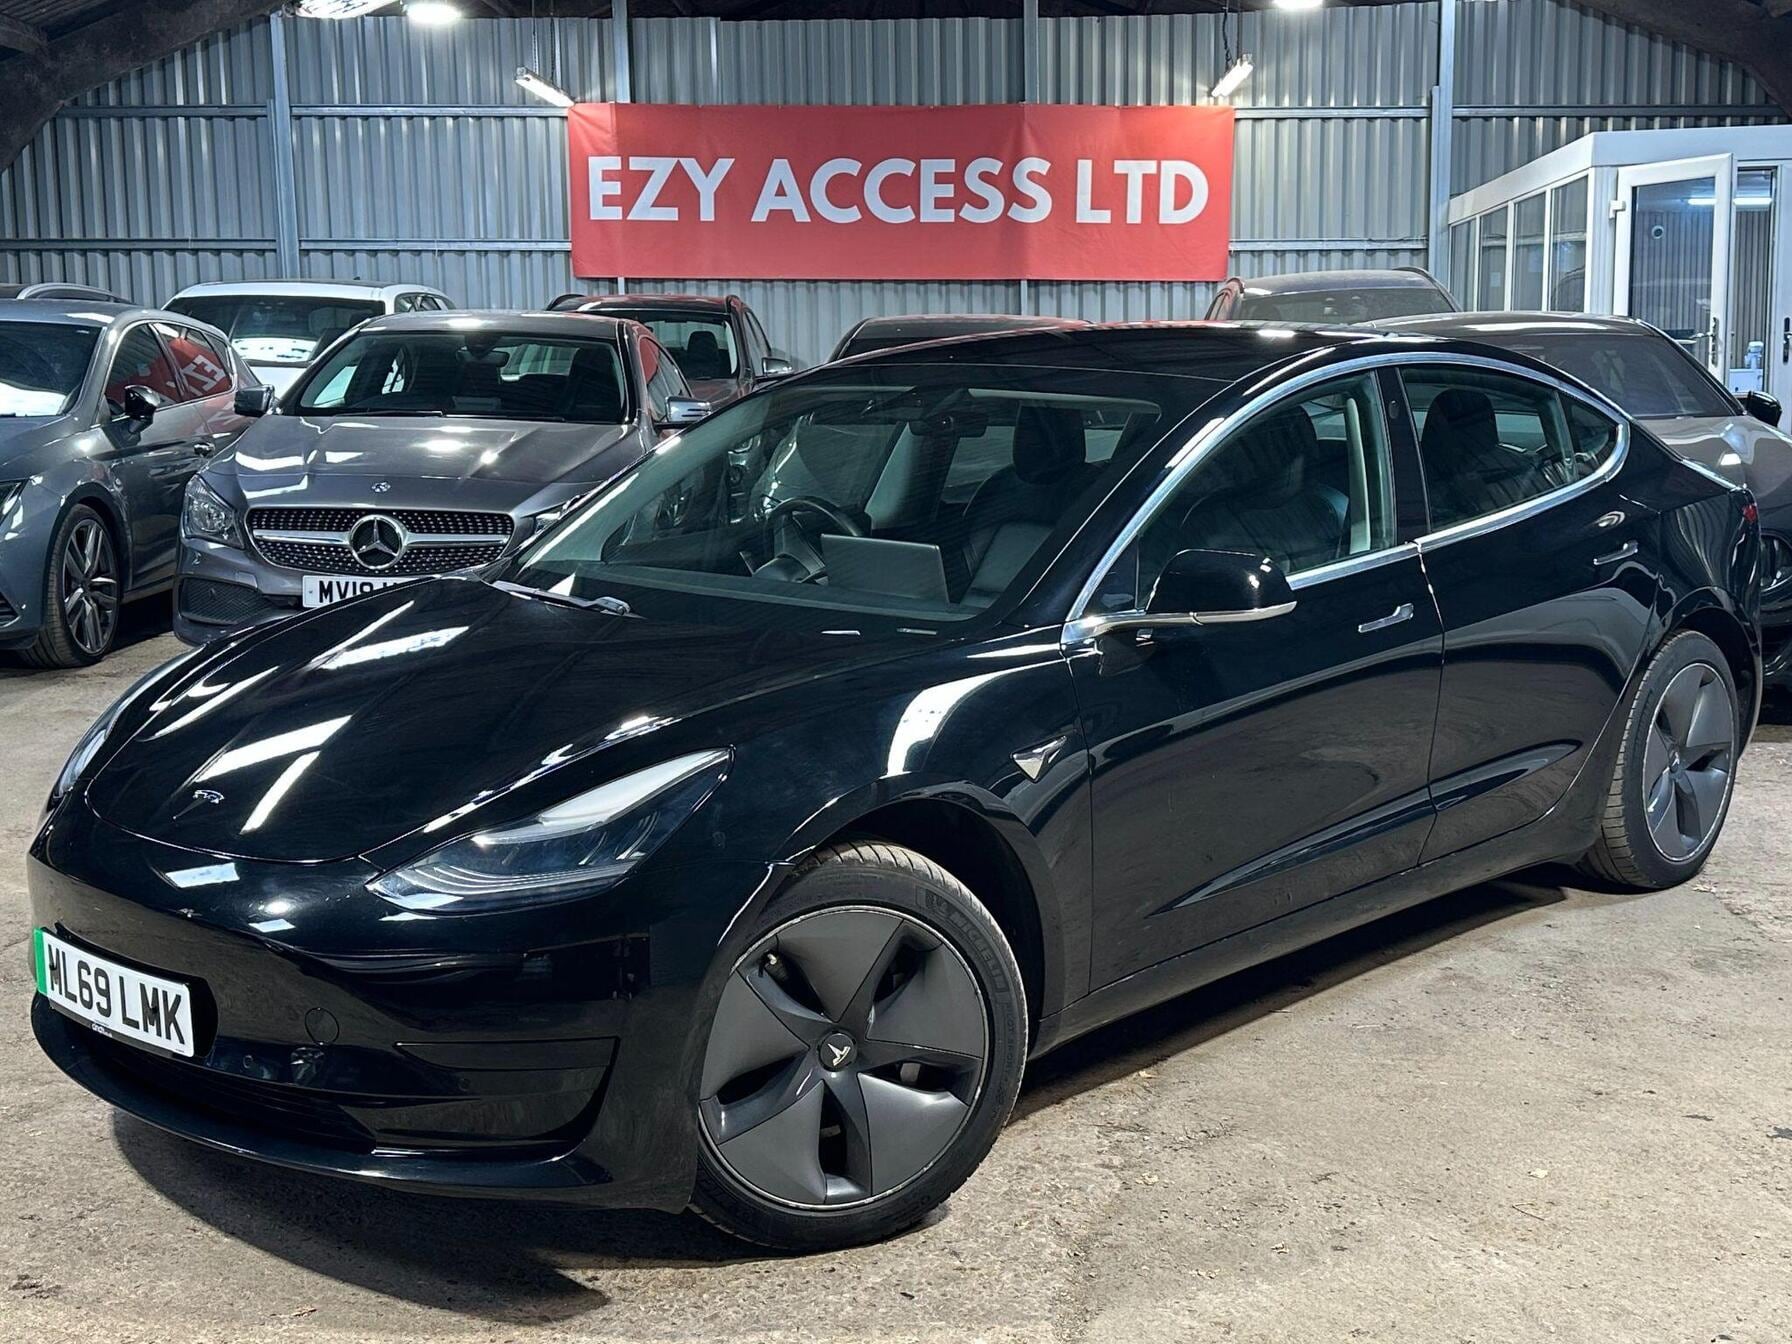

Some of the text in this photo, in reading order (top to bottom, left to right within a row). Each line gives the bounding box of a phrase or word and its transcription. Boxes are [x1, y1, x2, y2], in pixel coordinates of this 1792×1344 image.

[587, 156, 1209, 225] EZY ACCESS LTD
[48, 944, 185, 1045] ML69 LMK
